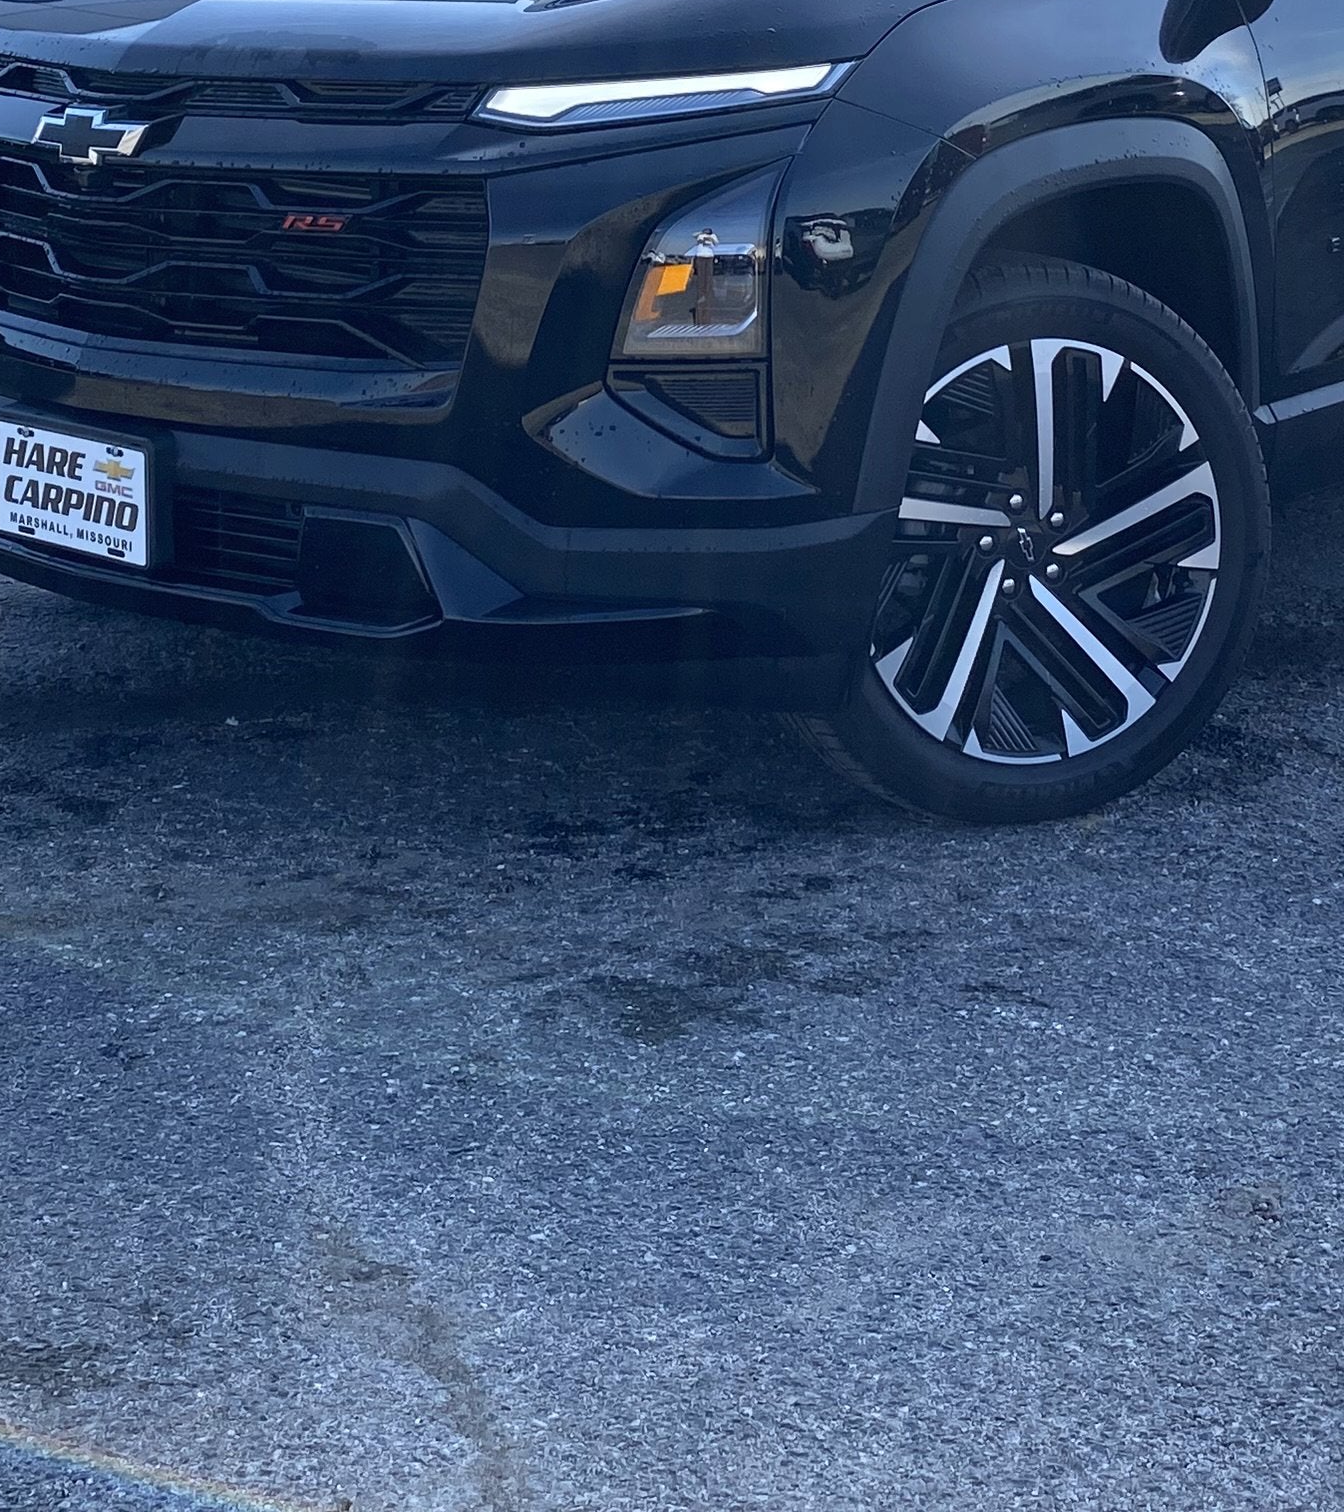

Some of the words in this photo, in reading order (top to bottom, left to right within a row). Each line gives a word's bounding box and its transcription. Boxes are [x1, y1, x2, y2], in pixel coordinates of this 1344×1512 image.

[282, 211, 347, 233] RS
[2, 436, 87, 482] HARE
[3, 474, 140, 533] CARPINO
[94, 479, 134, 499] GMC
[9, 511, 74, 539] MARSHALL,
[76, 527, 134, 553] MISSOURI
